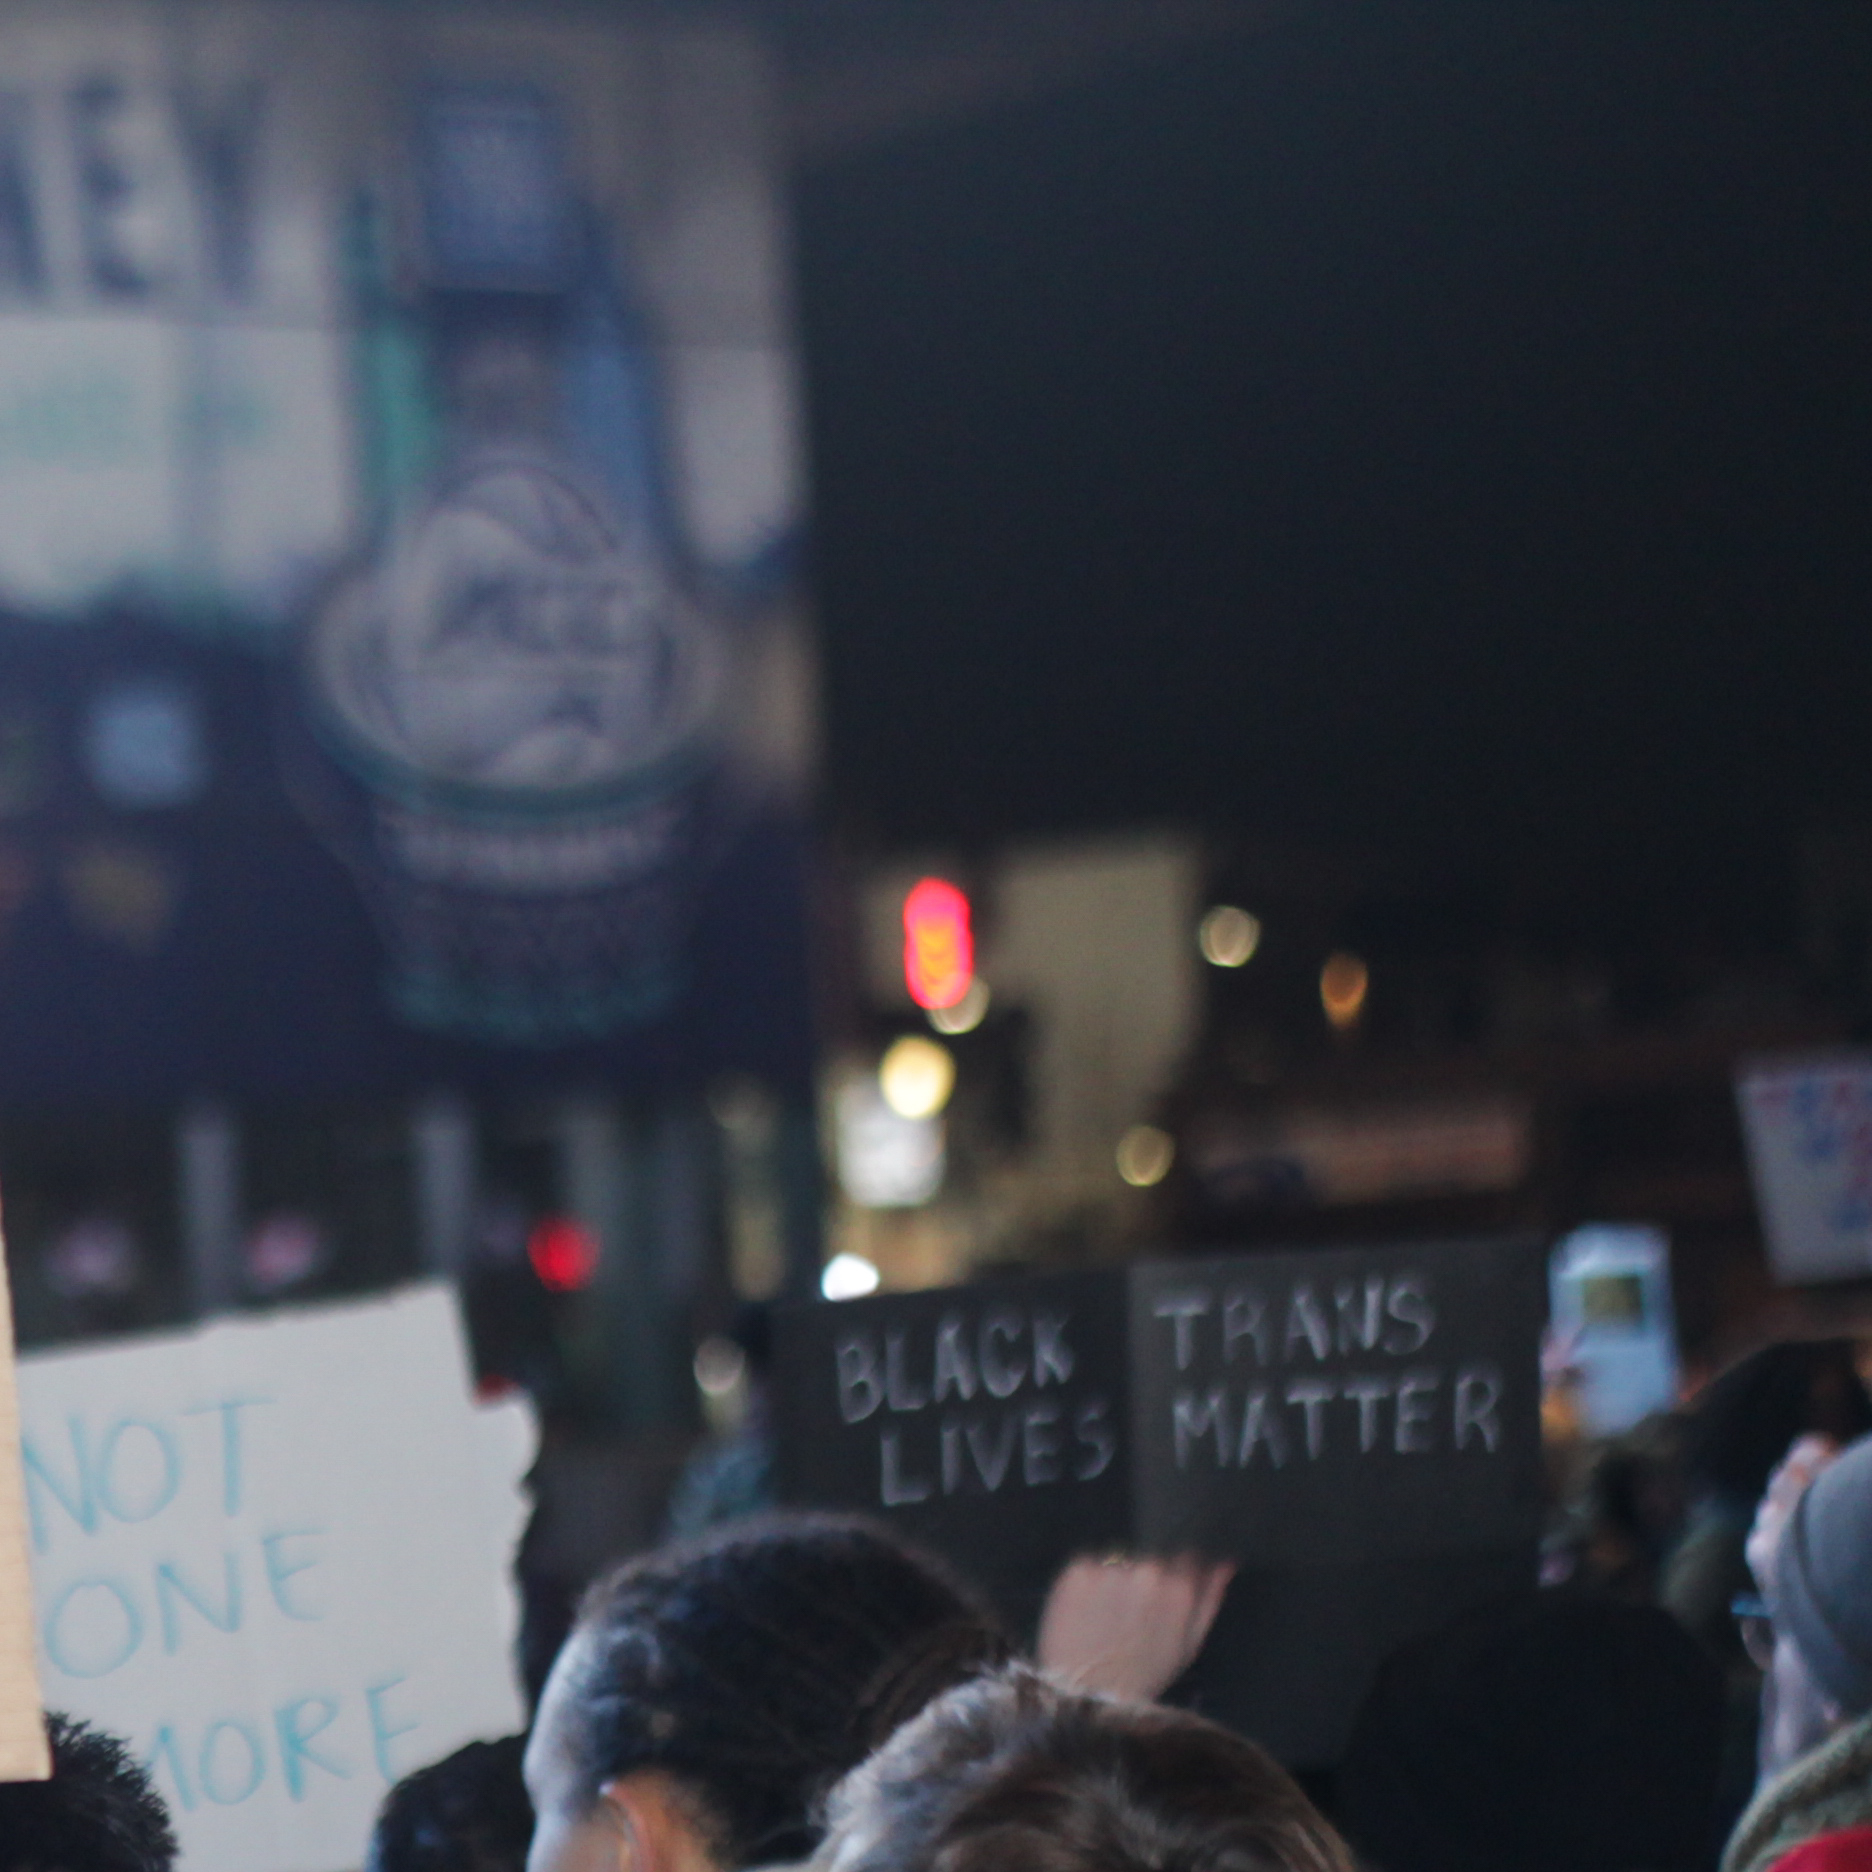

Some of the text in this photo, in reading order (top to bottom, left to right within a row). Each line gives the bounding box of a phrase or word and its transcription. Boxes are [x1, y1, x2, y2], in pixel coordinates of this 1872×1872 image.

[833, 1307, 1078, 1427] BLACK
[1152, 1273, 1440, 1373] TRANS
[20, 1396, 276, 1556] NOT
[876, 1396, 1117, 1508] LIVES
[1169, 1366, 1505, 1472] MATTER
[41, 1525, 327, 1679] ONE
